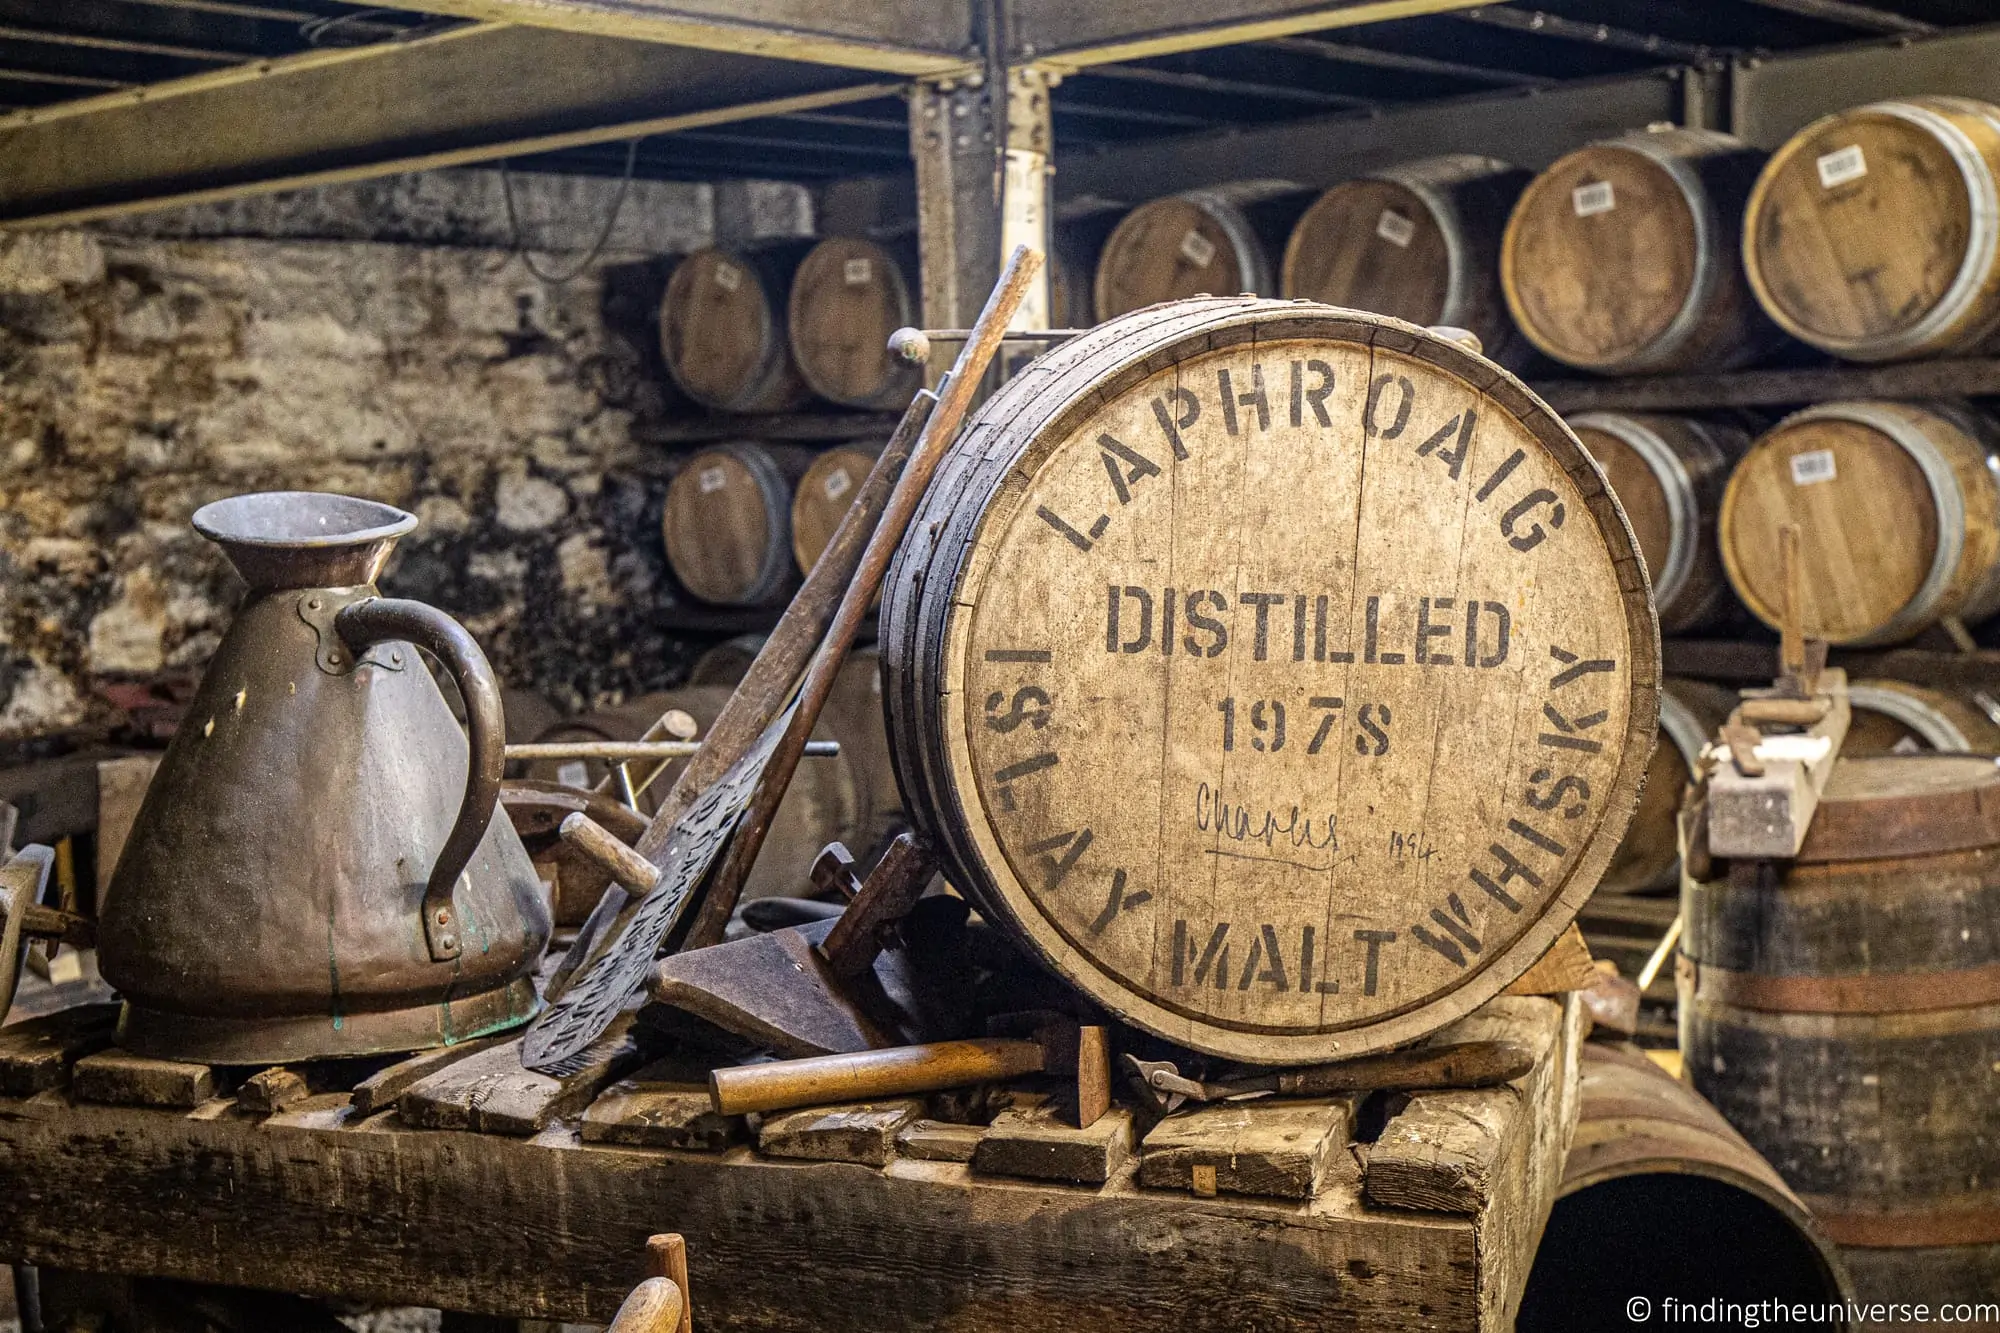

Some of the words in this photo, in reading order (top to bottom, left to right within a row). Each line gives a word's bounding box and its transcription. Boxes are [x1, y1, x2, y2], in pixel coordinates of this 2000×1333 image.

[1036, 359, 1565, 553] LAPHROAIG
[1106, 585, 1511, 669] DISTILLED
[984, 650, 1152, 935] ISLAY
[1171, 919, 1397, 997] MALT
[1411, 645, 1616, 968] WHISKY
